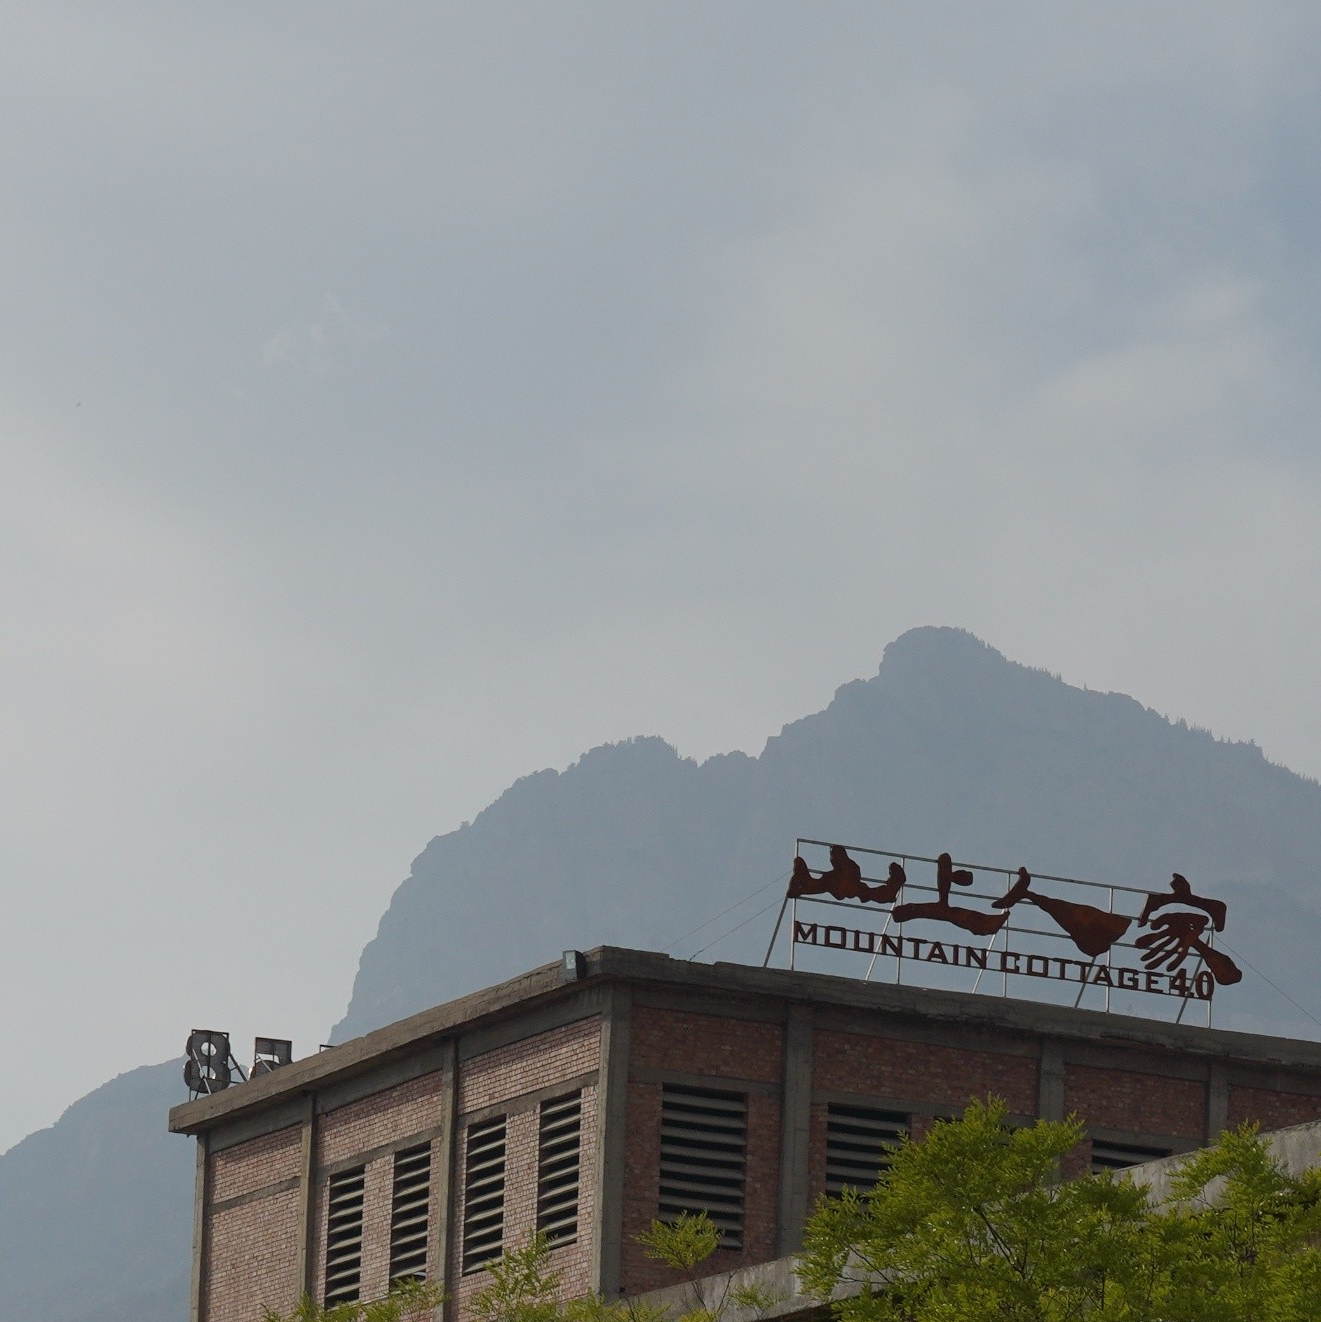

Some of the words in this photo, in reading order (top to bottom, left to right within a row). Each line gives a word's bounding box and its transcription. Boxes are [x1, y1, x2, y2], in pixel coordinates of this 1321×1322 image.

[788, 845, 1243, 985] 山上人家
[793, 920, 987, 970] MOUNTAIN
[1000, 952, 1164, 994] COTTAGE
